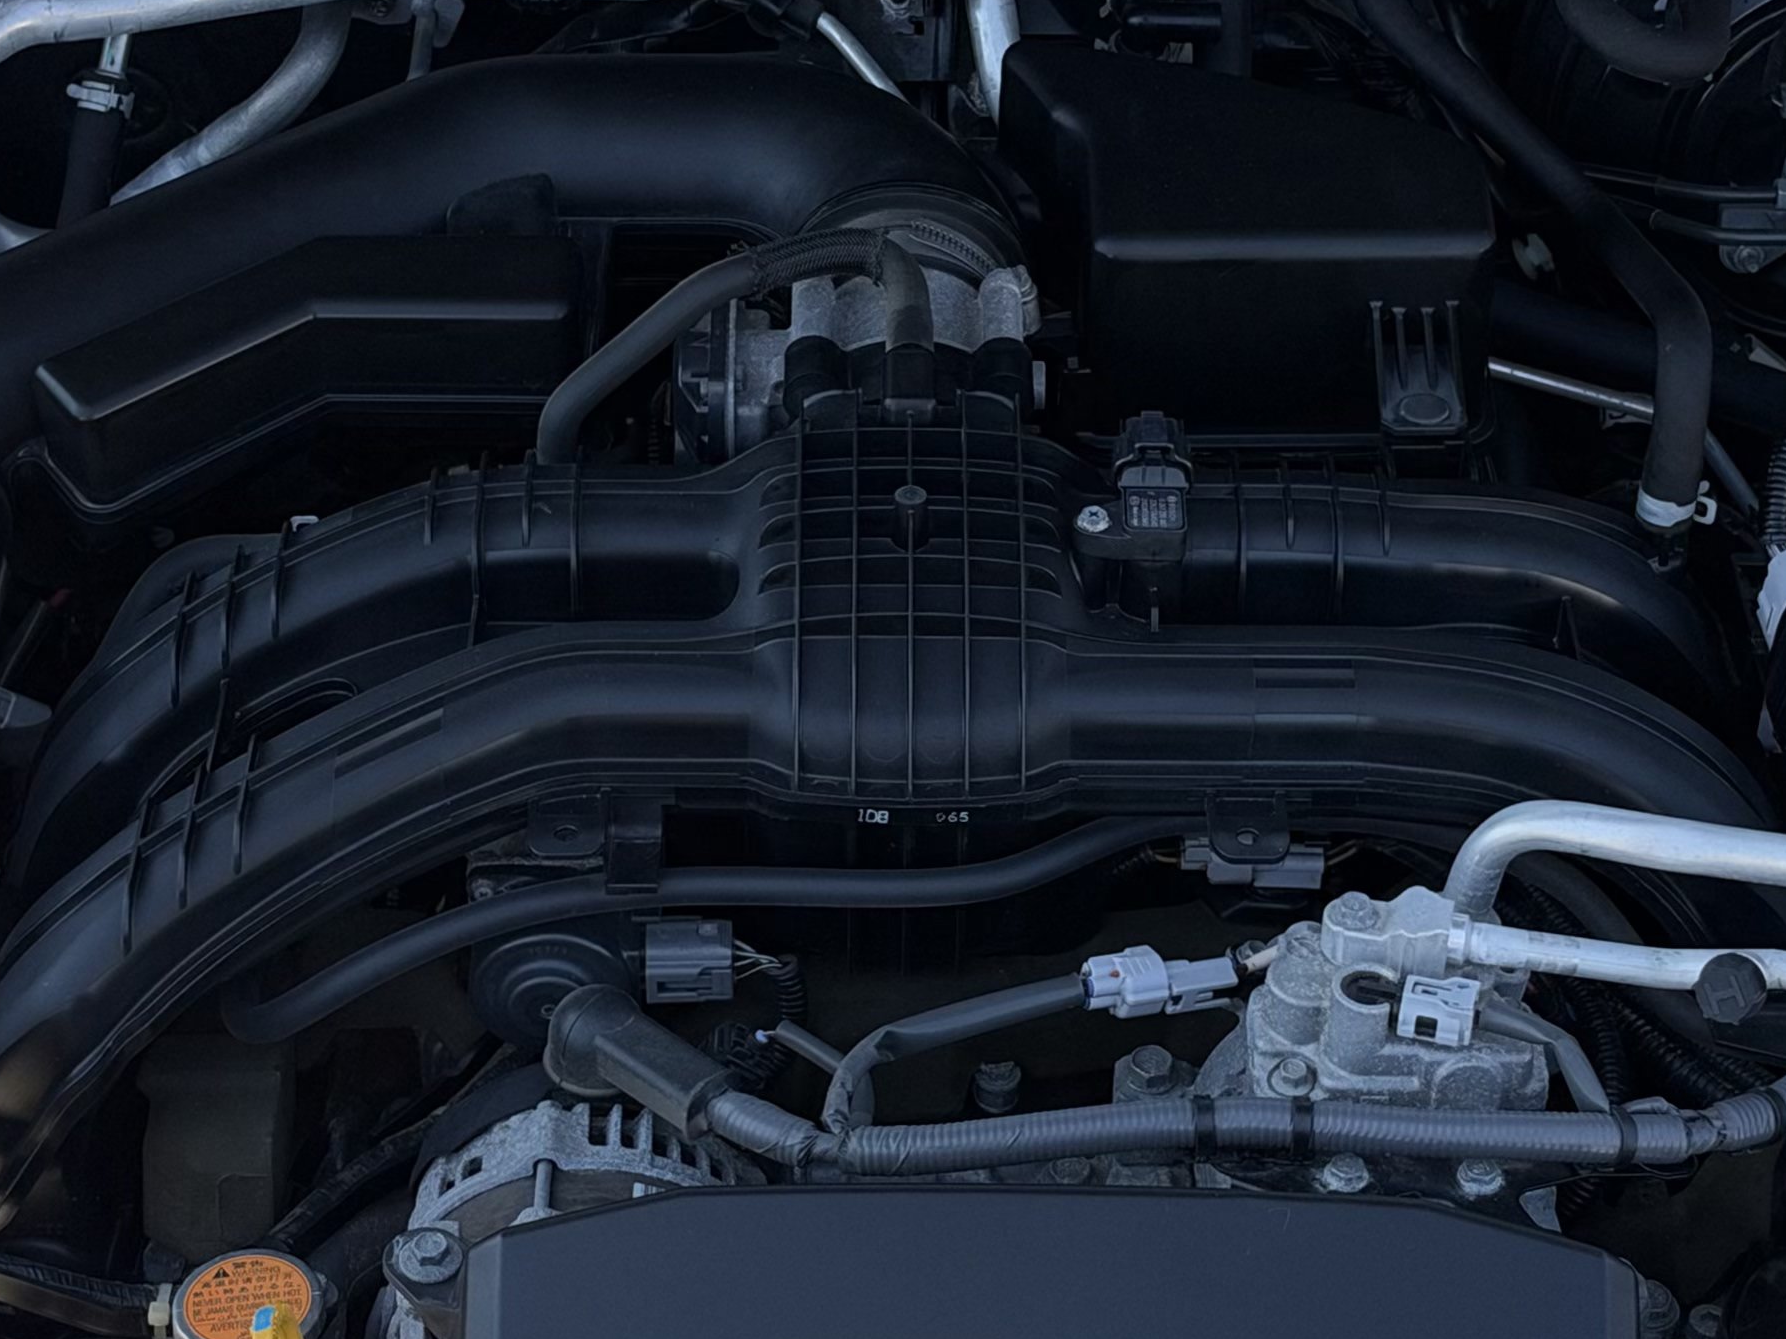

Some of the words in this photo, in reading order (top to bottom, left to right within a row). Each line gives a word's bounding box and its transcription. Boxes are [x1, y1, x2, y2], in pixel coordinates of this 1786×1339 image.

[231, 1266, 281, 1277] WARNING
[192, 1297, 222, 1308] NEVER
[225, 1294, 250, 1304] OPEN
[252, 1291, 281, 1301] WHEN
[210, 1320, 251, 1332] AVERTIS
